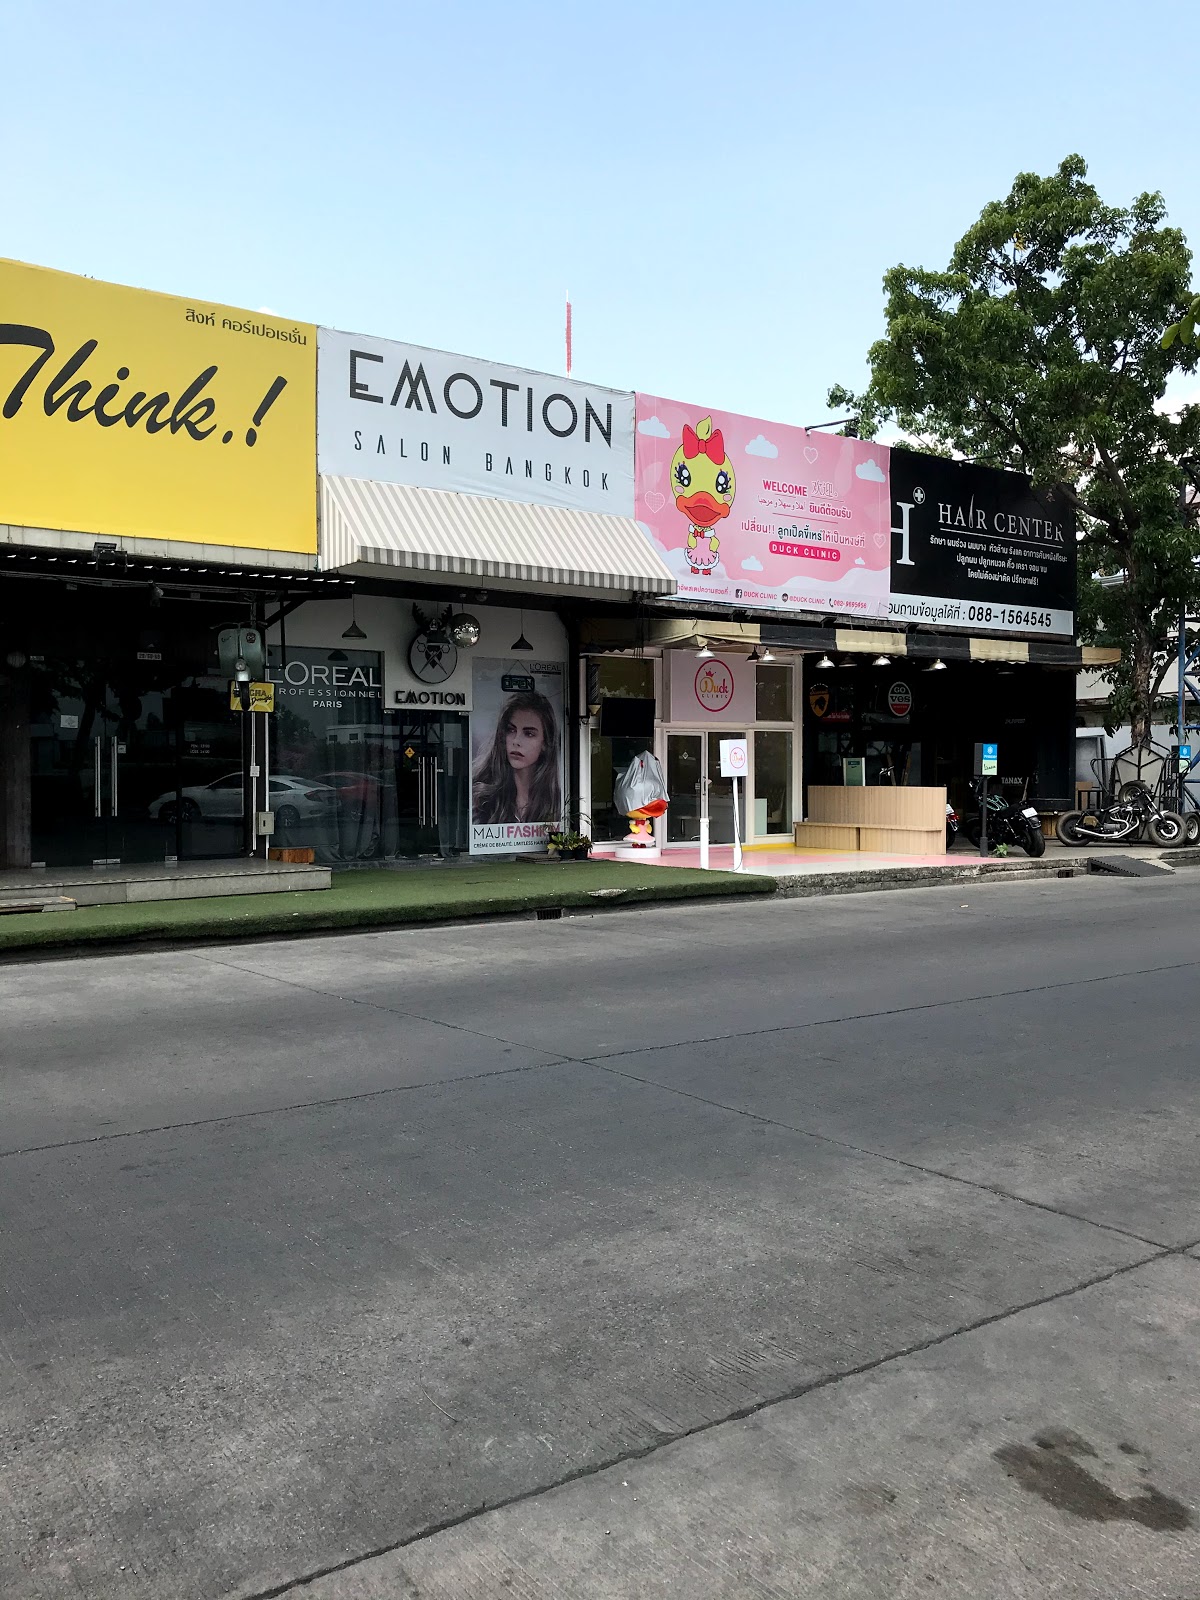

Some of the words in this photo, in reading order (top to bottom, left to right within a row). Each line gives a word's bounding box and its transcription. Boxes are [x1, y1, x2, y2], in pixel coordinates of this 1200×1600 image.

[186, 308, 216, 327] สิงห์
[222, 319, 307, 346] คอร์เปอเรชั่น
[349, 349, 613, 448] EMOTION
[354, 430, 451, 466] SALON
[486, 452, 609, 491] BANGKOK
[763, 479, 808, 497] WELCOME
[809, 502, 852, 519] ยินดีต้อนรับ
[938, 494, 988, 531] HAIR
[993, 512, 1065, 543] CENTER
[771, 543, 799, 555] DUCK
[803, 547, 838, 560] CLINIC
[743, 590, 759, 599] DUCK
[759, 592, 778, 601] CLINIC
[808, 597, 825, 605] CLINIC
[968, 605, 1052, 628] 088-1564545
[278, 687, 382, 699] ROFESSIONNEL
[700, 677, 729, 694] Duck
[313, 700, 343, 709] PARIS
[395, 689, 466, 706] EMOTION
[473, 826, 504, 840] MAJI
